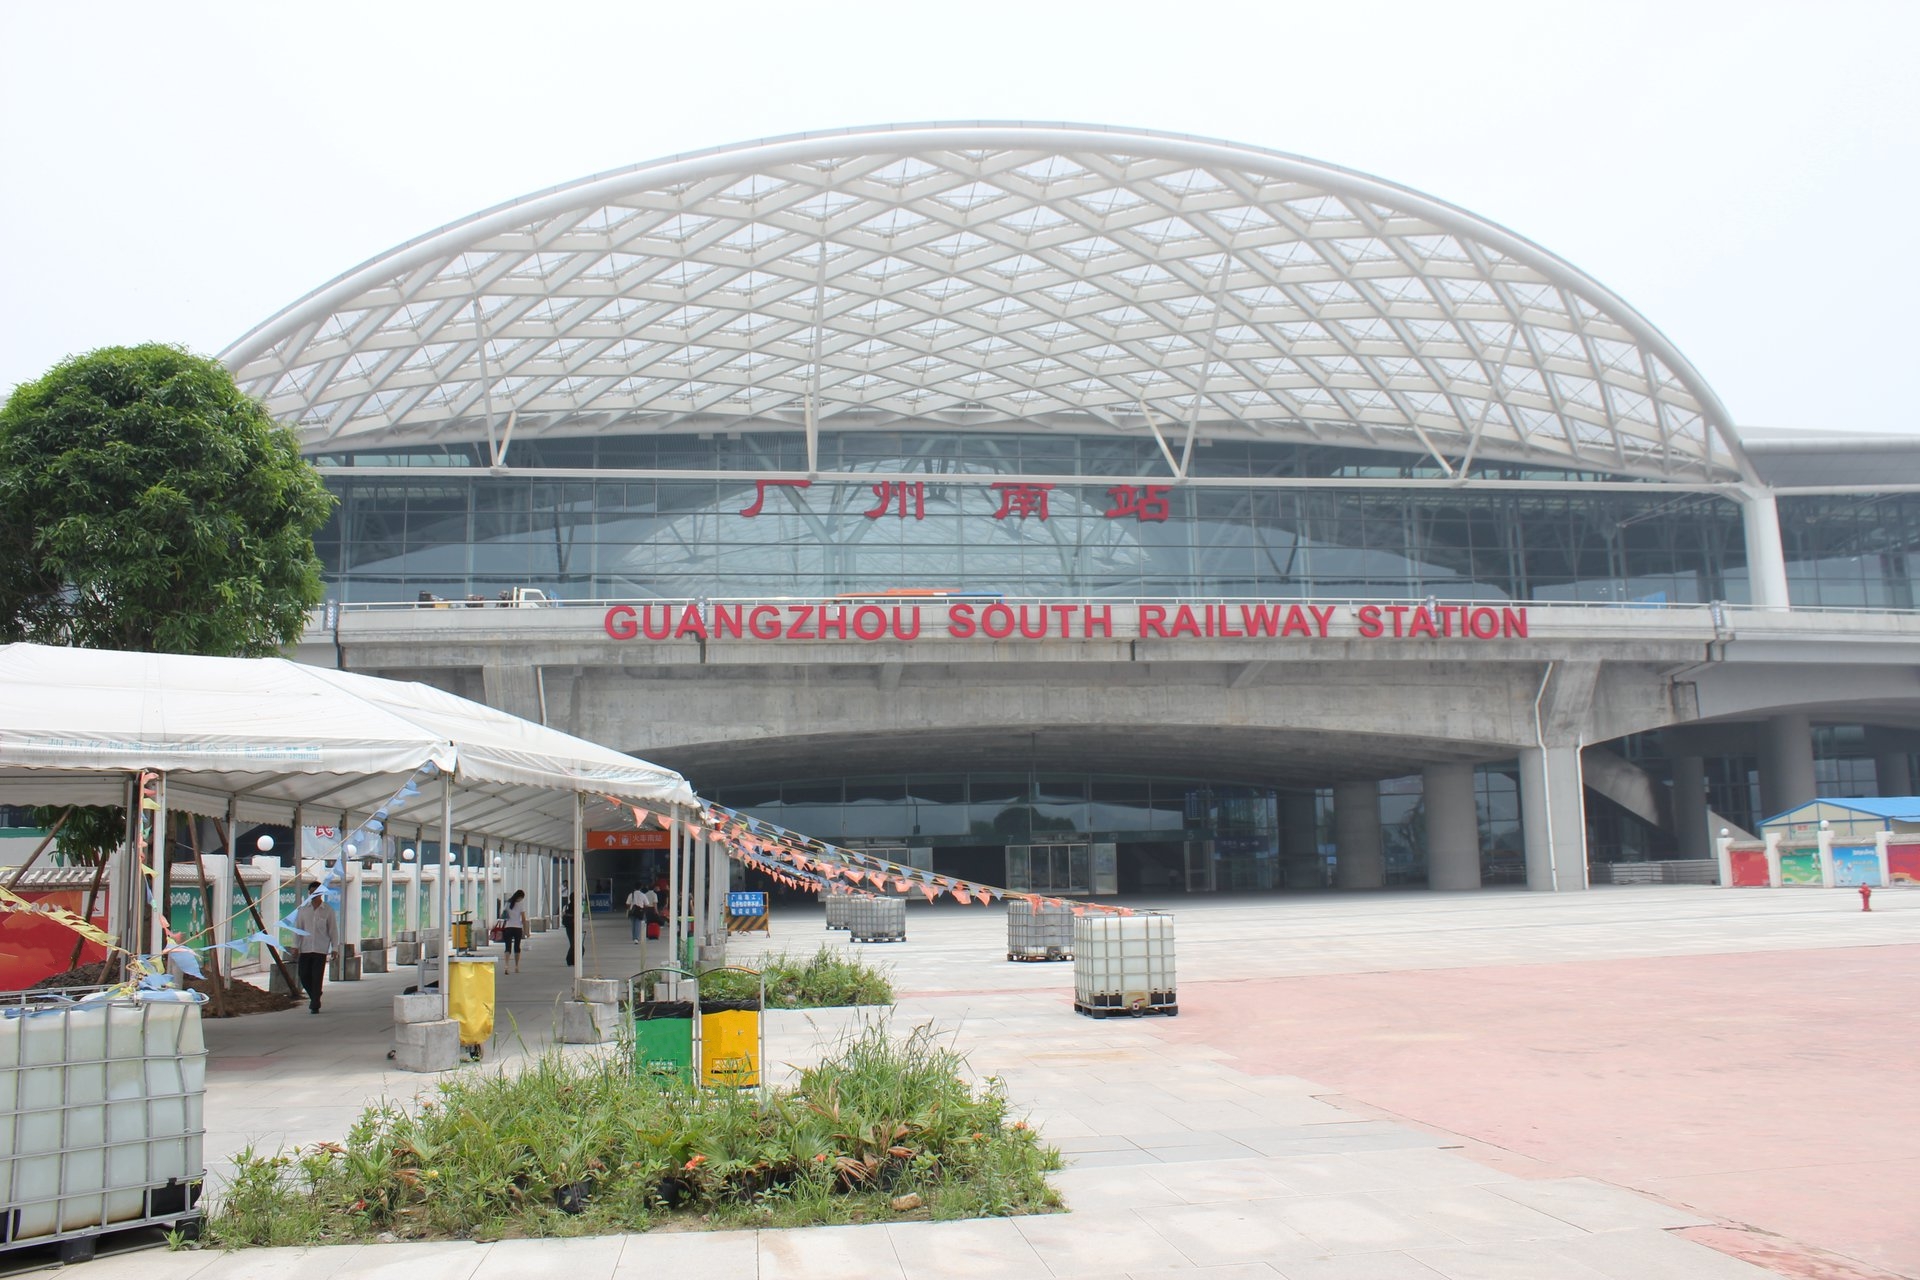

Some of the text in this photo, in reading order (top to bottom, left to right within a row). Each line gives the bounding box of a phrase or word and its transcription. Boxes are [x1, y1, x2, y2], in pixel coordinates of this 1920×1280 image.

[739, 479, 1172, 521] 广州南站
[604, 603, 1529, 641] GUANGZHOU SOUTH RAILWAY STATION
